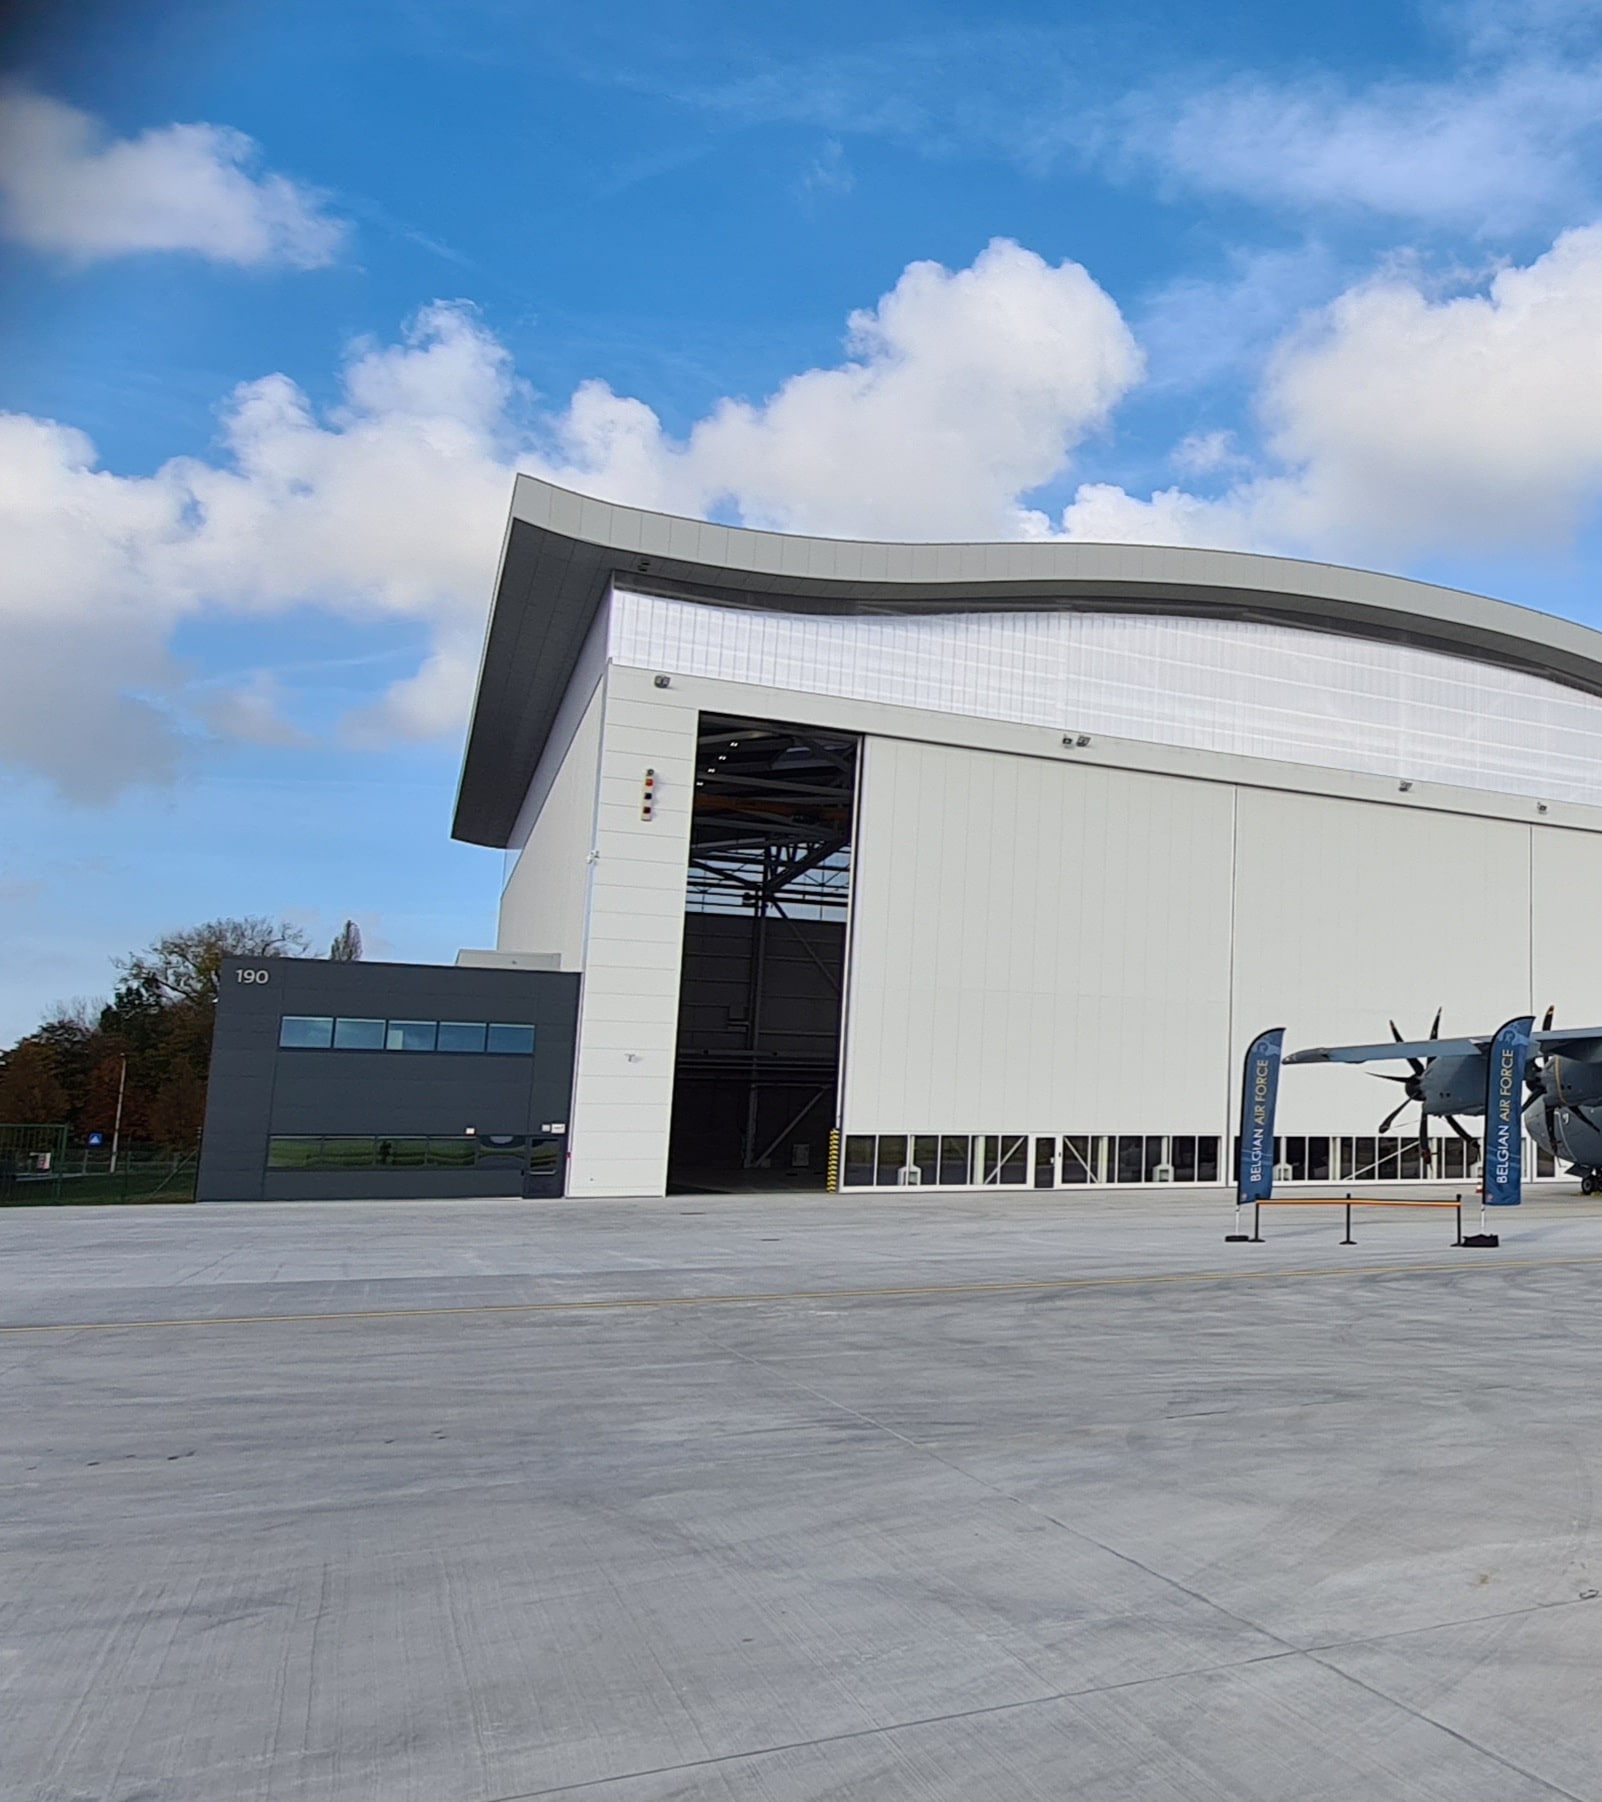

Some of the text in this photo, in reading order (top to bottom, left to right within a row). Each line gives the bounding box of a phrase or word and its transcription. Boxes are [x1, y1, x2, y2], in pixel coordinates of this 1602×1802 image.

[235, 969, 269, 984] 190
[1250, 1060, 1269, 1182] BELGIAN AIR FORCE
[1497, 1049, 1514, 1183] BELGIAN AIR FORCE
